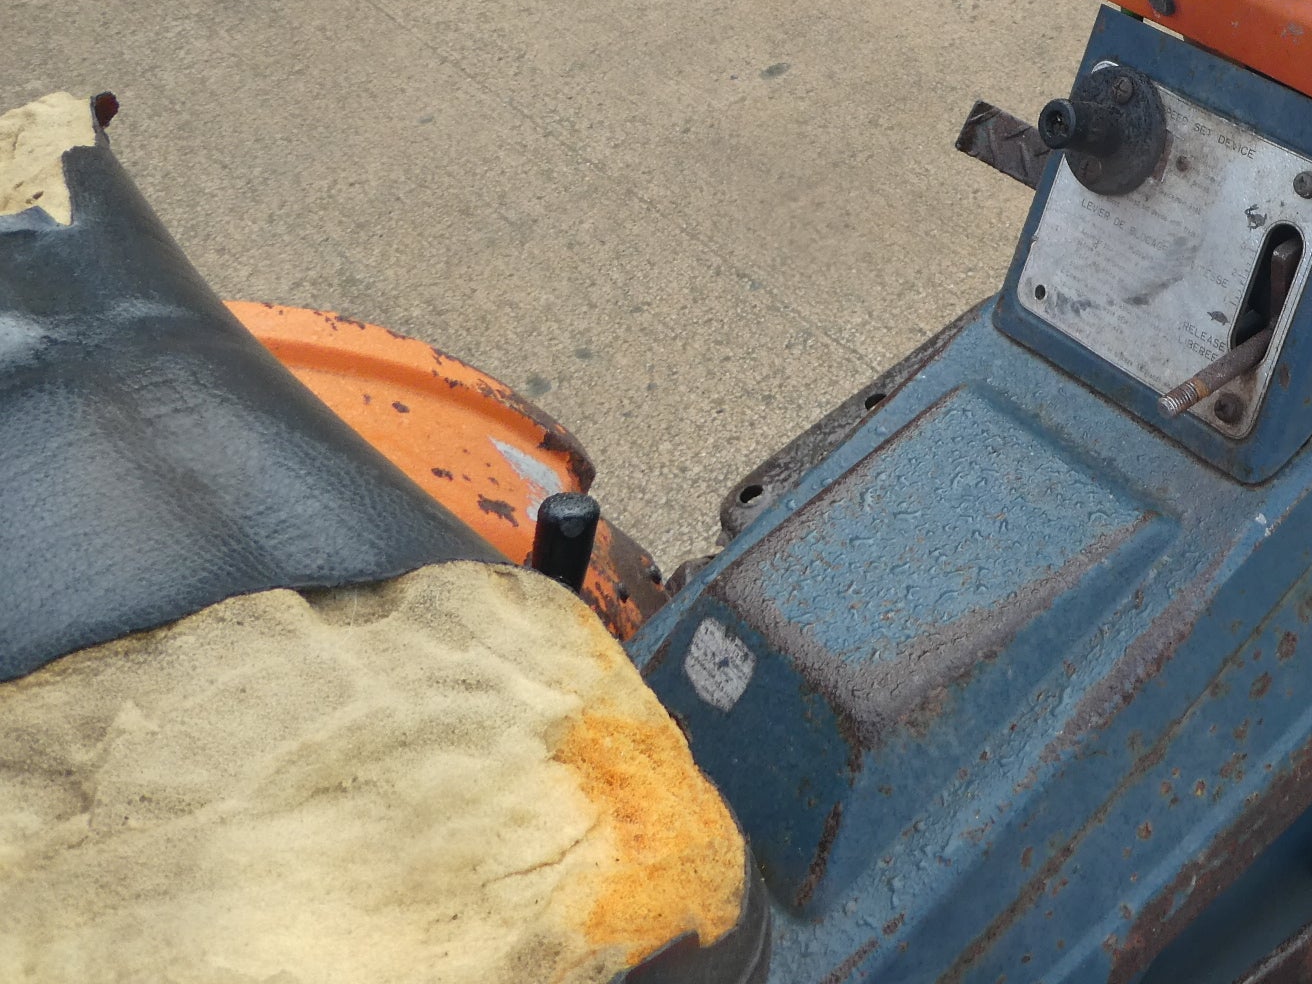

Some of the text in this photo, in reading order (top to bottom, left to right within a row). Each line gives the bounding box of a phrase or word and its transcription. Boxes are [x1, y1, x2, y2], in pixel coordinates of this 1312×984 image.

[1193, 122, 1211, 137] SET
[1218, 135, 1257, 160] DEVICE
[1183, 322, 1227, 353] RELEASE
